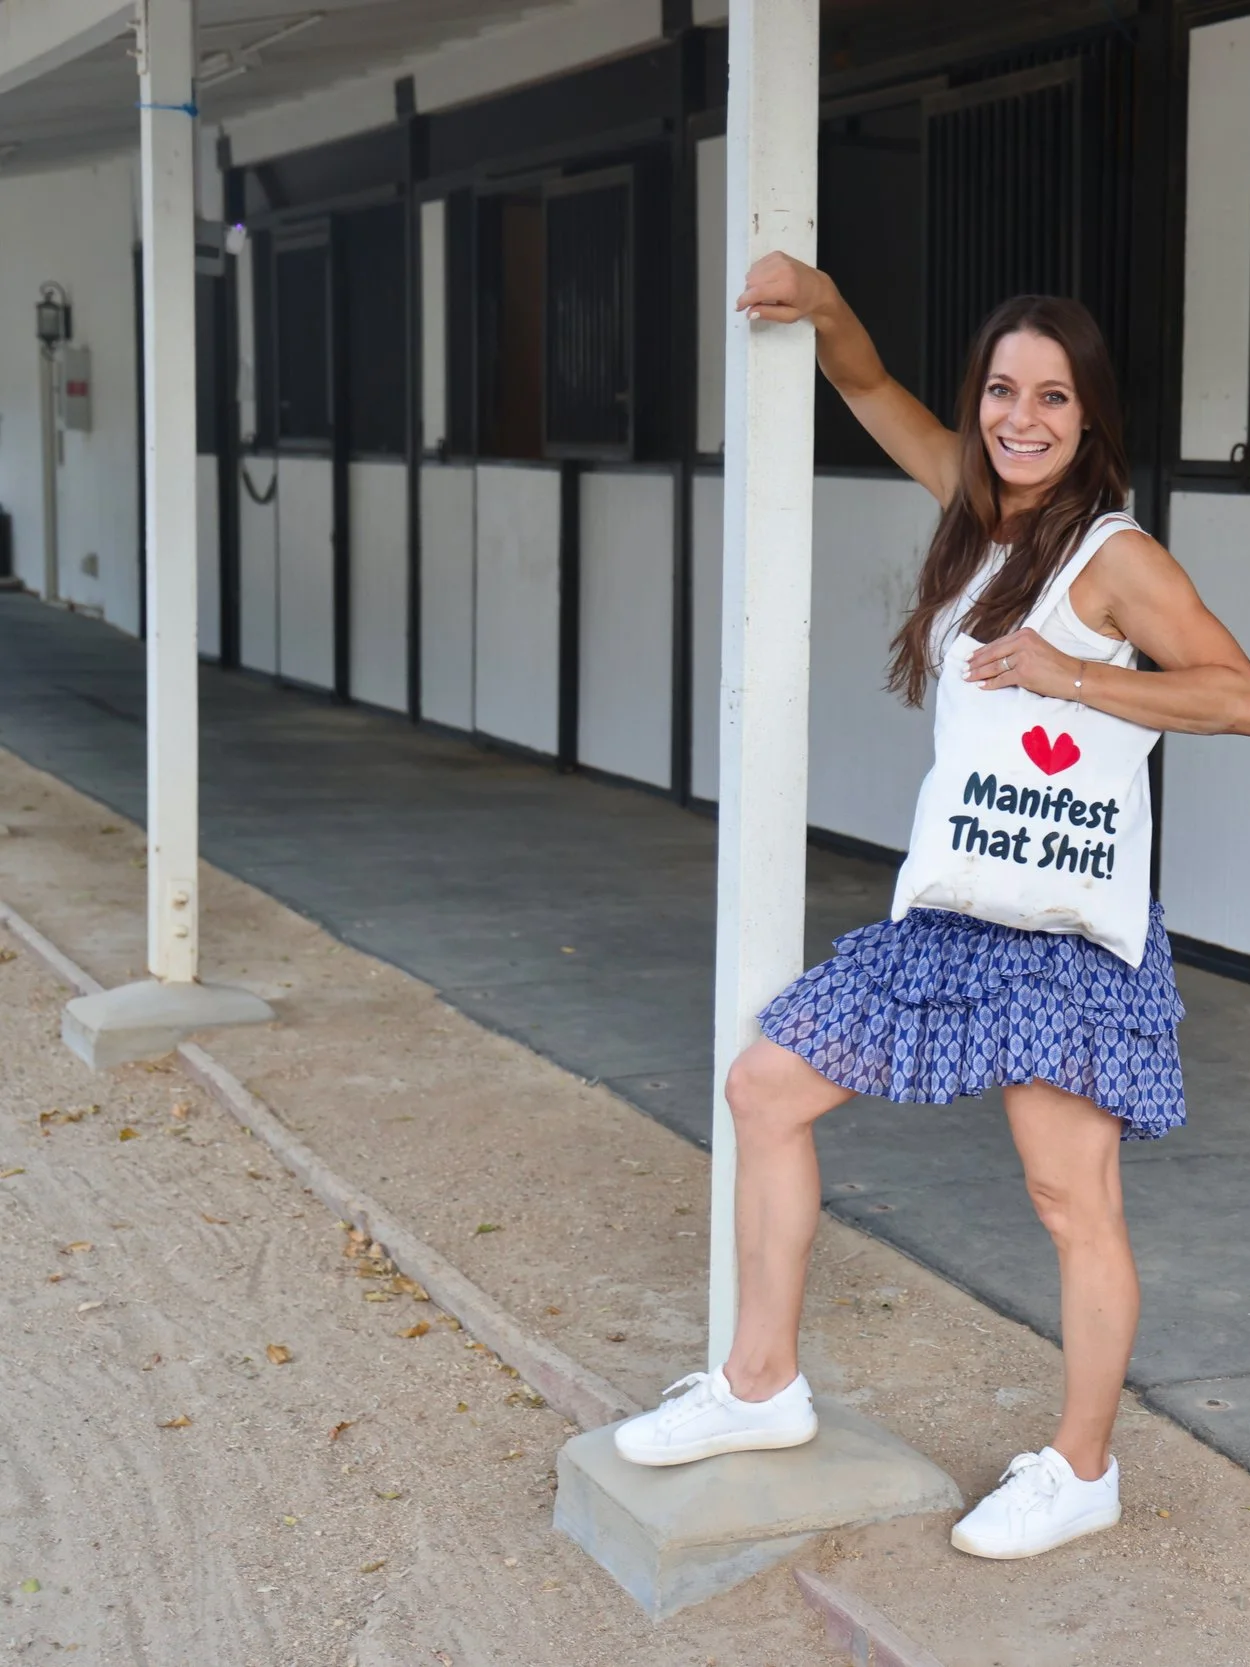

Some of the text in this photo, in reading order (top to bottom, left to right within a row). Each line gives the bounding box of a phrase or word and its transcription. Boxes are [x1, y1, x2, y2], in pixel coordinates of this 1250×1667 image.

[963, 771, 1119, 834] Manifest
[948, 815, 1115, 880] That Shit!
